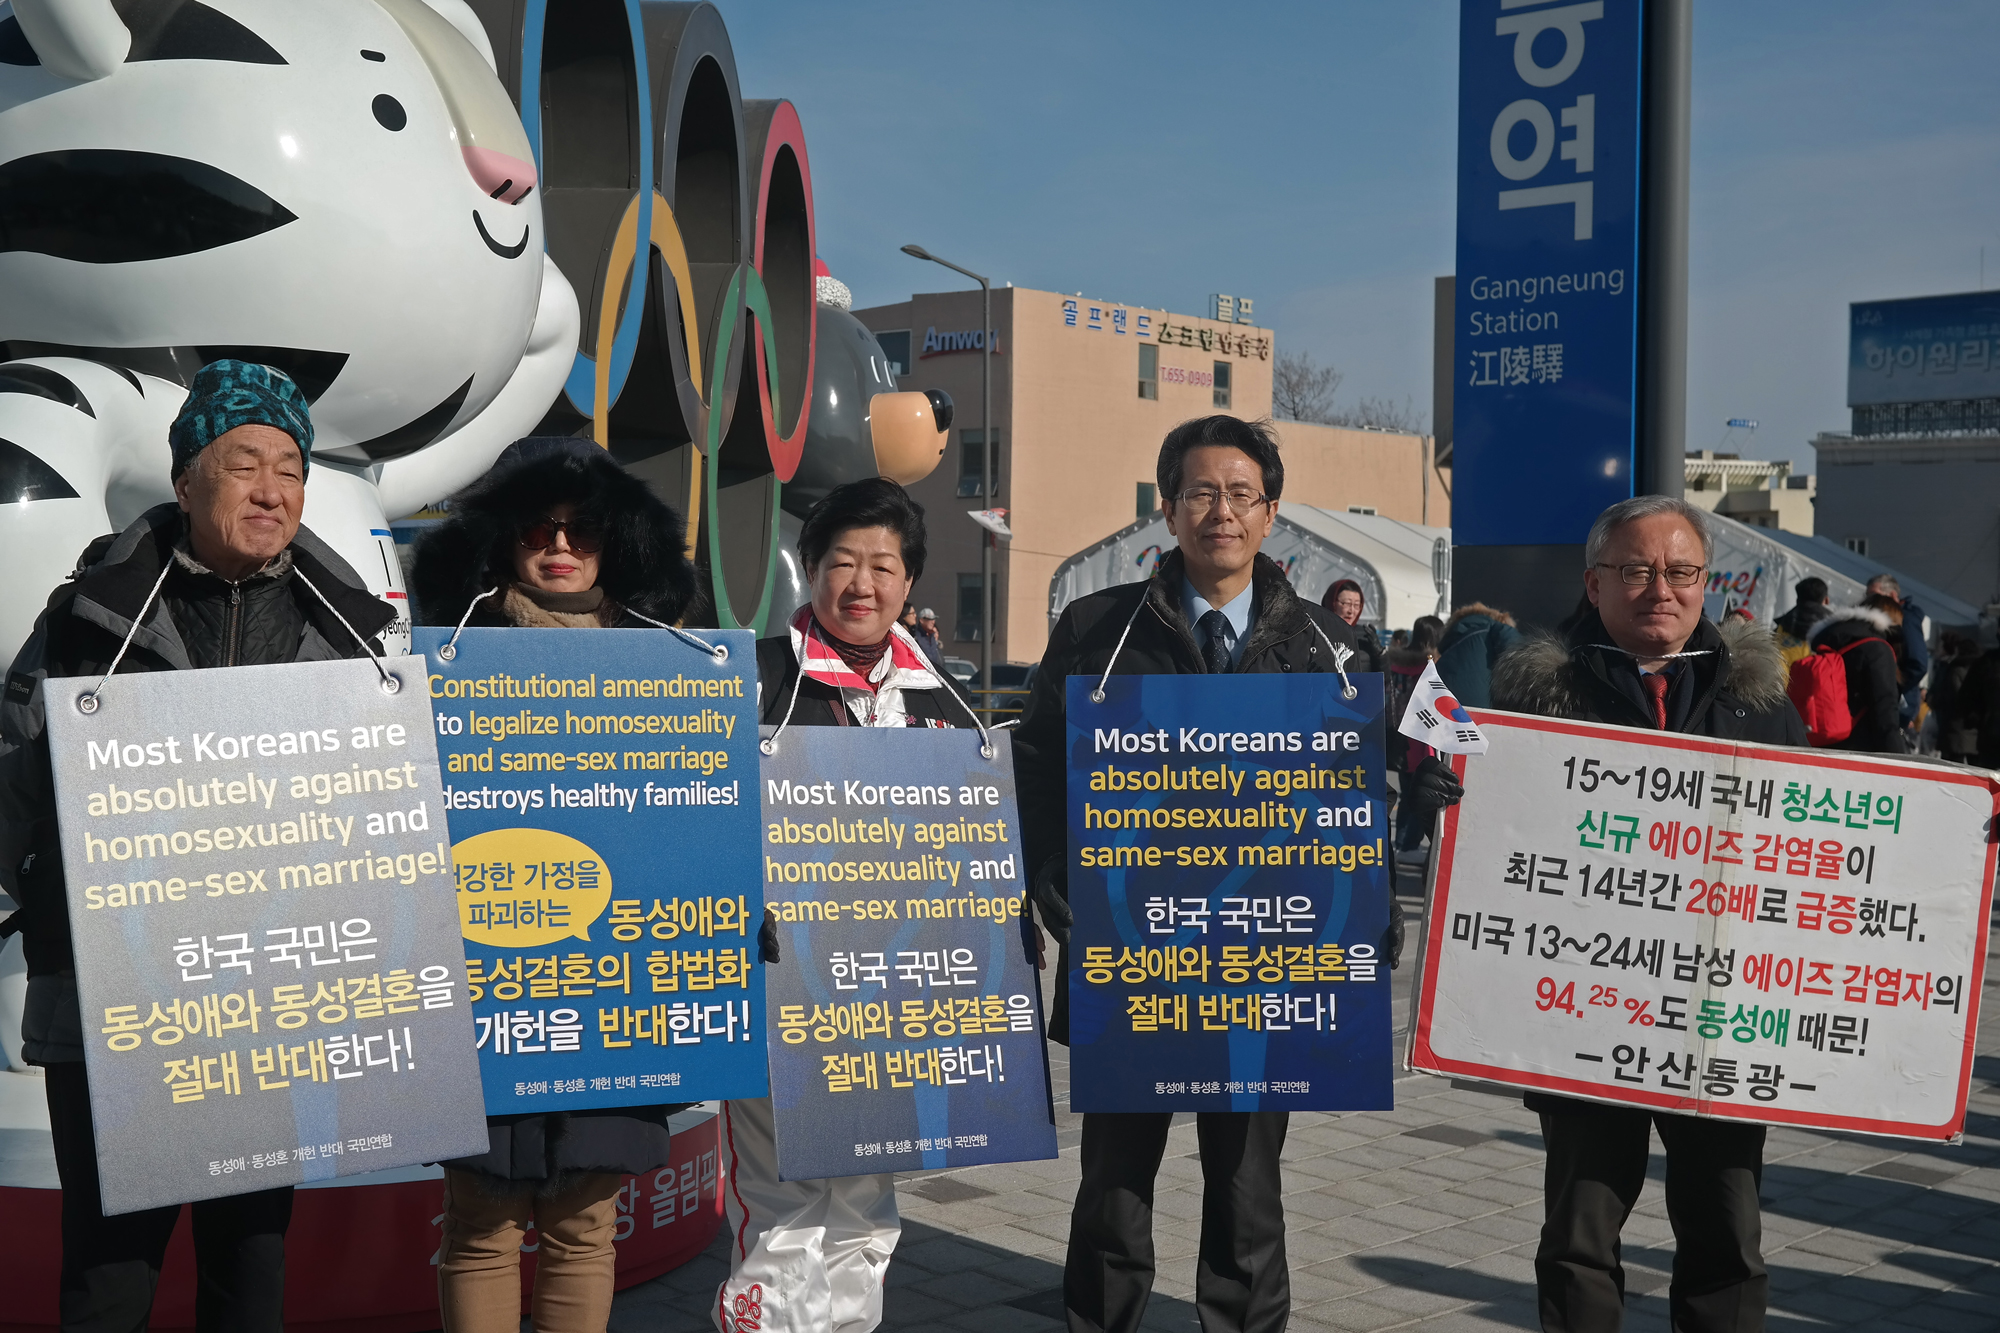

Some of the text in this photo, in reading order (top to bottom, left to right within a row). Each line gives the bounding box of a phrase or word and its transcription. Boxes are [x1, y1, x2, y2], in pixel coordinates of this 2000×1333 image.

[1470, 269, 1624, 303] Gangneung
[1063, 299, 1151, 337] 골프랜드
[1216, 293, 1254, 324] 골프
[1470, 308, 1558, 336] Station
[922, 326, 998, 353] Amway
[1864, 338, 2000, 377] 하이원리
[1160, 366, 1213, 387] T.655-0909
[1469, 343, 1563, 387] 江陵驛
[428, 673, 744, 698] Constitutional amendment
[436, 709, 736, 741] to legalize homosexuality
[1094, 727, 1360, 753] Most Koreans are
[87, 721, 406, 770] Most Koreans are
[447, 747, 728, 776] and same-sex marriage
[88, 761, 417, 817] absolutely against
[442, 780, 739, 815] destroys healthy families!
[767, 779, 999, 806] Most Koreans are
[1089, 762, 1366, 797] absolutely against
[1563, 756, 1903, 834] 15~19세 국내 청소년의
[85, 802, 429, 863] homosexuality and
[767, 817, 1008, 849] absolutely against
[1085, 800, 1372, 834] homosexuality and
[1080, 838, 1383, 872] same-sex marriage!
[1576, 809, 1876, 884] 신규 에이즈 감염율이
[85, 842, 448, 910] same-sex marriage!
[524, 860, 601, 890] 가정을
[766, 854, 1016, 887] homosexuality and
[468, 899, 571, 930] 파괴하는
[765, 890, 1029, 924] same-sex marriage!
[1145, 895, 1316, 934] 한국 국민은
[1503, 851, 1926, 943] 최근 14년간 26배로 급증했다.
[608, 895, 750, 941] 동성애와
[173, 917, 378, 981] 한국 국민은
[1082, 943, 1378, 983] 동성애와 동성결혼을
[1452, 911, 1963, 1014] 미국 13~24세 남성 에이즈 감염자의
[466, 948, 751, 1002] 동성결혼의 합법화
[829, 947, 978, 990] 한국 국민은
[102, 964, 456, 1052] 동성애와 동성결혼을
[777, 993, 1034, 1045] 동성애와 동성결혼을
[1126, 993, 1337, 1033] 절대 반대한다!
[475, 1000, 750, 1056] 개헌을 반대한다!
[1695, 999, 1791, 1048] 동성애
[1797, 1012, 1869, 1056] 때문!
[163, 1026, 416, 1104] 절대 반대한다!
[590, 1077, 611, 1091] 개헌
[614, 1075, 636, 1089] 반대
[639, 1072, 681, 1087] 국민연합
[821, 1044, 1004, 1093] 절대 반대한다!
[1224, 1081, 1244, 1093] 개헌
[1247, 1081, 1267, 1093] 반대
[1270, 1081, 1310, 1094] 국민연합
[292, 1146, 316, 1161] 개헌
[320, 1141, 343, 1158] 반대
[347, 1133, 392, 1153] 국민연합
[915, 1138, 932, 1151] 개헌
[934, 1137, 953, 1150] 반대
[955, 1133, 988, 1148] 국민연합
[649, 1144, 717, 1230] 올림픽
